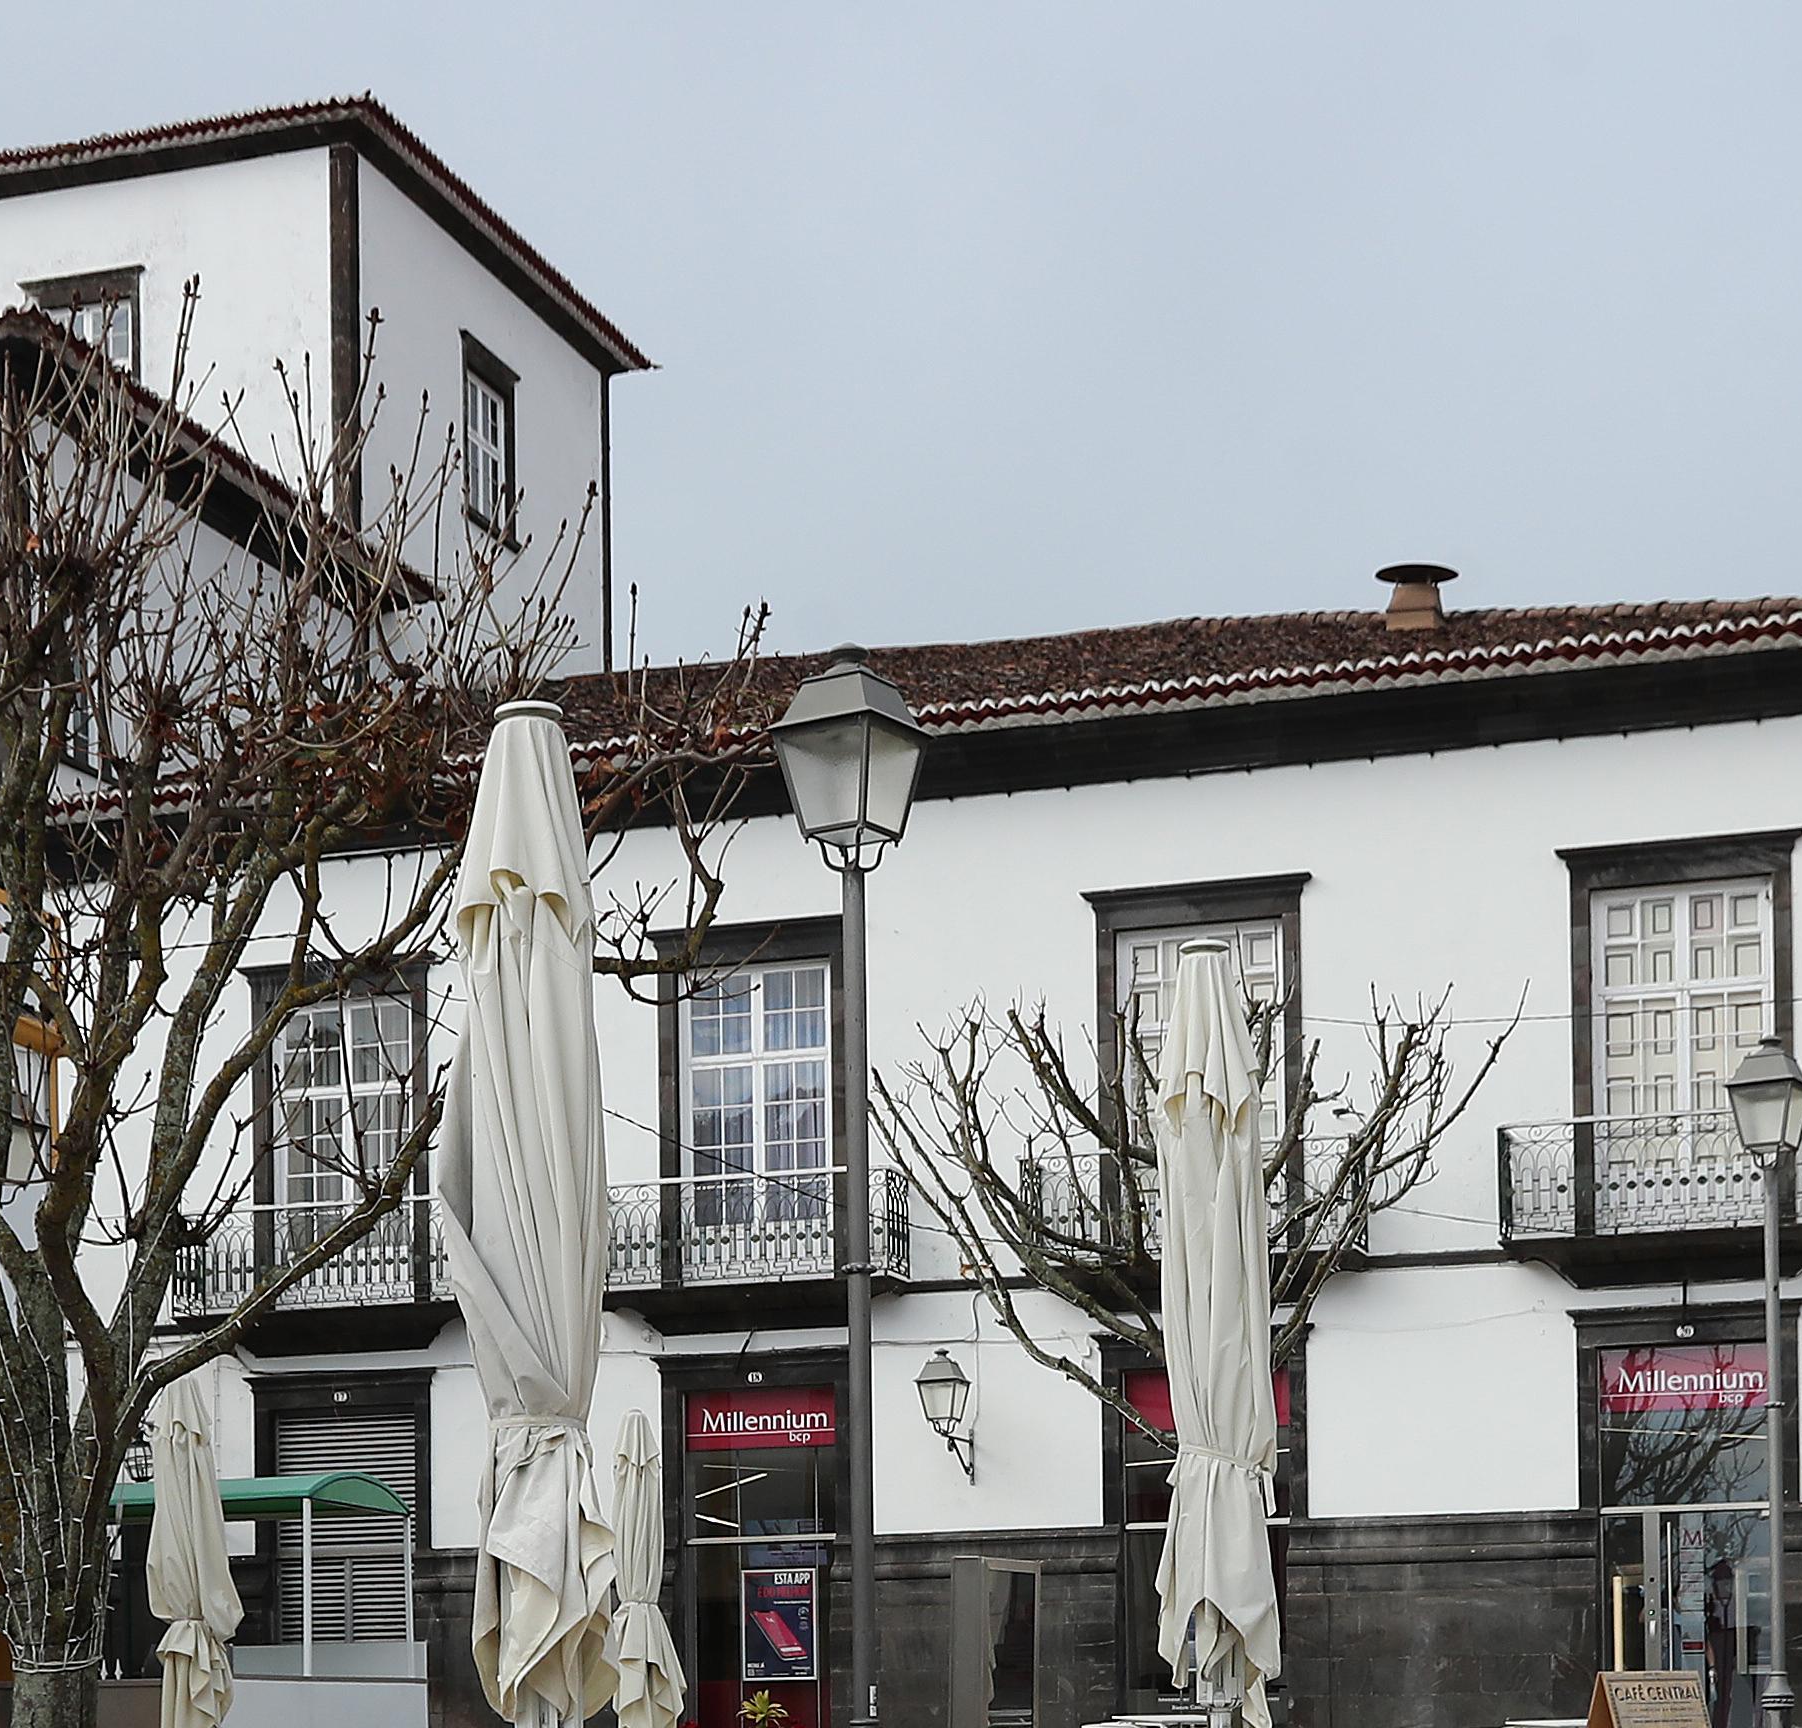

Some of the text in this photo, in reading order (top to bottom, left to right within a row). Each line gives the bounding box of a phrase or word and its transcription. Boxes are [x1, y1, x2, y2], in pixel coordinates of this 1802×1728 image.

[1618, 1367, 1764, 1393] Millennium
[1718, 1392, 1744, 1405] bcp
[702, 1408, 828, 1433] Millennium
[789, 1432, 811, 1444] bcp
[774, 1572, 811, 1585] ESTA APP
[1614, 1683, 1700, 1701] CAFÉ CENTRAL
